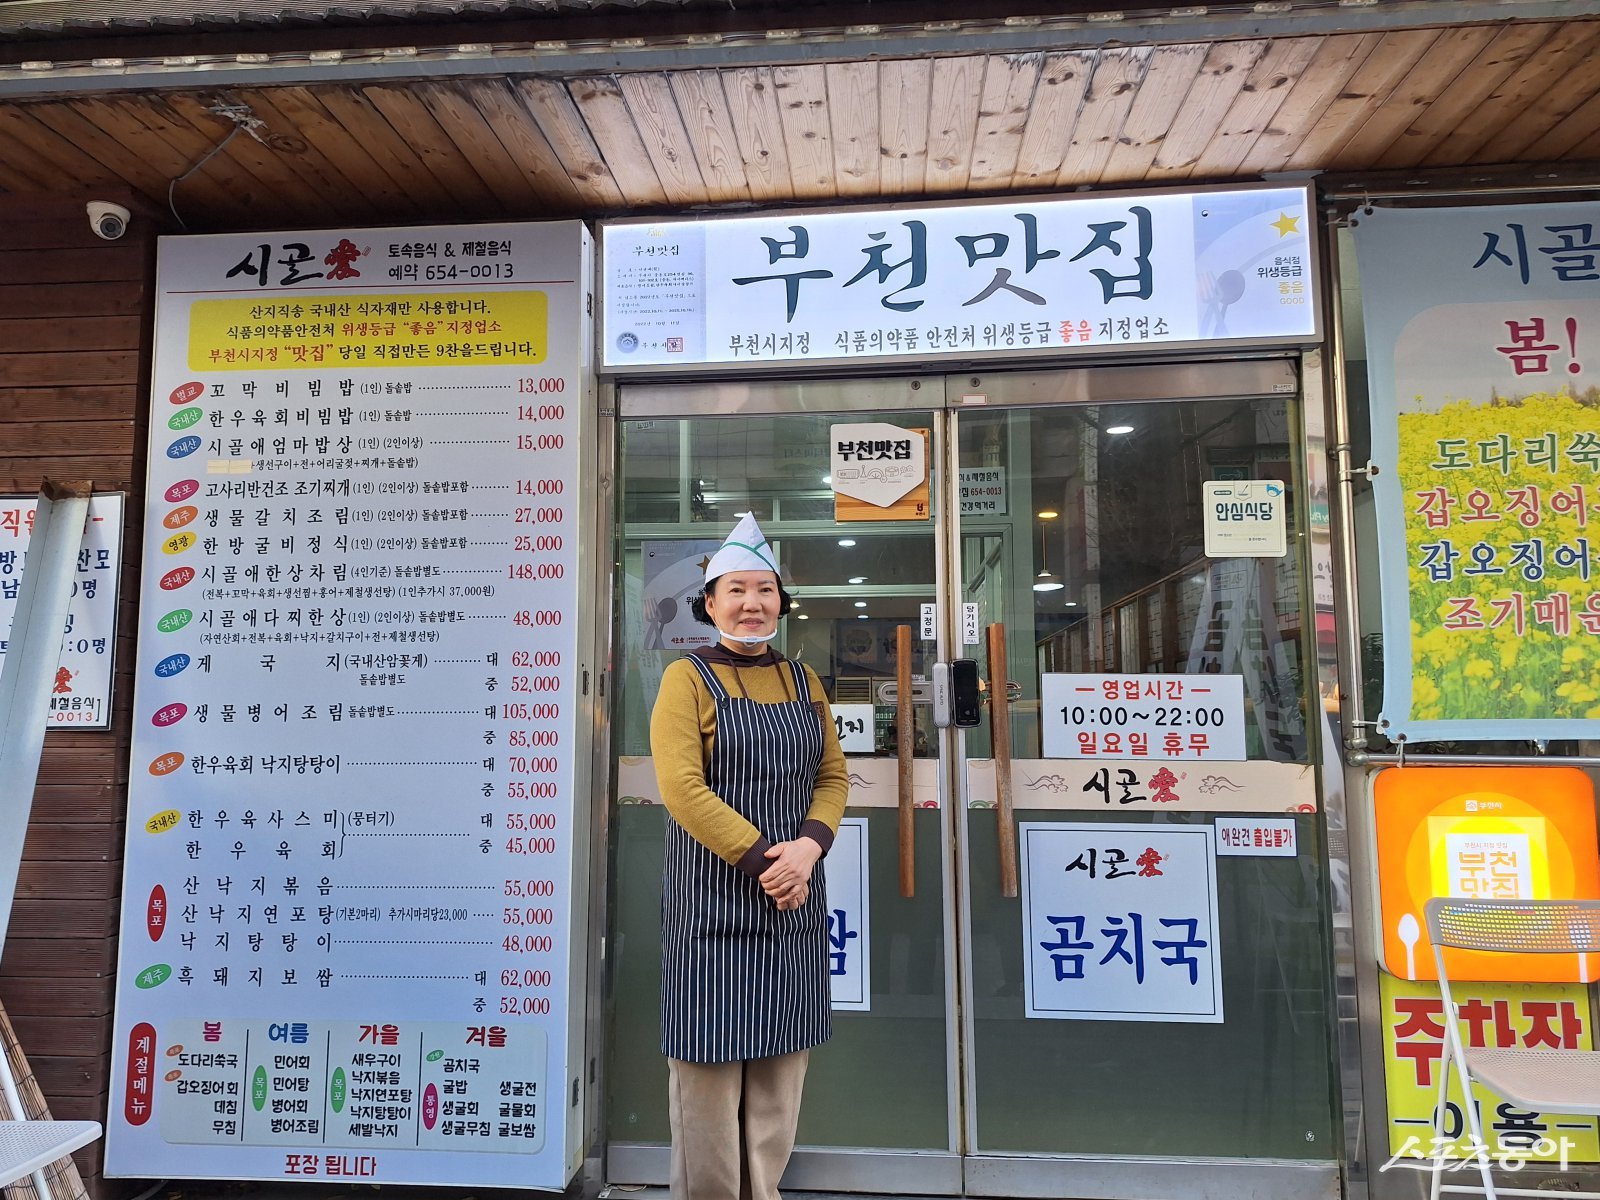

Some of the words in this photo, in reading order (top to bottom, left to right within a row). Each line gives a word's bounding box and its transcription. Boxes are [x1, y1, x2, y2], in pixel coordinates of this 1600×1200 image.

[388, 244, 438, 258] 토속음식
[462, 239, 513, 256] 제철음식
[632, 244, 680, 256] 부천맛집
[1474, 223, 1600, 284] 시골
[732, 206, 1152, 323] 부천맛집
[1274, 256, 1300, 265] 음식점
[388, 264, 418, 281] 예약
[425, 263, 514, 280] 654-0013
[1257, 265, 1303, 278] 위생등급
[1278, 281, 1304, 294] 좋음
[250, 304, 304, 319] 산지직송
[310, 303, 352, 318] 국내산
[356, 302, 412, 317] 식자재만
[418, 300, 492, 316] 사용합니다.
[1280, 297, 1305, 305] GOOD
[226, 322, 335, 338] 식품의약품안전처
[342, 321, 395, 336] 위생등급
[446, 318, 502, 334] 지정업소
[729, 331, 810, 357] 부천시지정
[834, 326, 919, 354] 식품의약품
[926, 322, 976, 351] 안전처
[983, 320, 1051, 346] 위생등급
[1058, 319, 1092, 343] 좋음
[1098, 316, 1170, 340] 지정업소
[208, 347, 278, 364] 부천시지정
[339, 344, 367, 360] 당일
[374, 343, 431, 359] 직접만든
[436, 341, 537, 358] 9찬을드립니다.
[1496, 317, 1582, 376] 봄!
[176, 385, 197, 402] 벌교
[210, 378, 354, 399] 꼬막비빔밥
[516, 378, 564, 395] 13,000
[171, 411, 199, 428] 국내산
[209, 406, 354, 428] 한우육회비빔밥
[516, 405, 564, 422] 14,000
[170, 438, 196, 457] 국내산
[208, 436, 352, 456] 시골애엄마밥상
[516, 434, 564, 452] 15,000
[837, 439, 911, 462] 부천맛집
[171, 484, 193, 498] 목포
[206, 480, 289, 500] 고사리반건조
[294, 478, 350, 498] 조기찌개
[516, 479, 564, 497] 14,000
[970, 487, 1002, 496] 654-0013
[170, 510, 190, 525] 제주
[204, 506, 348, 528] 생물갈치조림
[514, 507, 562, 525] 27,000
[1215, 502, 1273, 522] 안심식당
[1416, 486, 1600, 528] 갑오징어
[203, 534, 348, 555] 한방굴비정식
[514, 536, 562, 554] 25,000
[1420, 539, 1600, 581] 갑오징어
[163, 570, 190, 588] 국내산
[202, 564, 346, 583] 시골애한상차림
[508, 564, 564, 581] 148,000
[160, 612, 188, 630] 국내산
[200, 608, 346, 628] 시골애다찌한상
[512, 610, 562, 628] 48,000
[924, 606, 932, 636] 고정문
[966, 606, 976, 637] 당기시오
[158, 656, 187, 677] 국내산
[486, 652, 498, 667] 대
[512, 650, 560, 670] 62,000
[485, 676, 498, 692] 중
[511, 676, 560, 694] 52,000
[1102, 680, 1184, 700] 영업시간
[194, 703, 343, 722] 생물병어조림
[485, 704, 497, 720] 대
[502, 704, 559, 722] 105,000
[1060, 706, 1224, 726] 10:00~22:00
[482, 731, 497, 745] 중
[508, 729, 558, 748] 85,000
[1077, 732, 1148, 756] 일요일
[1162, 732, 1210, 756] 휴무
[190, 754, 254, 776] 한우육회
[261, 754, 341, 776] 낙지탕탕이
[482, 757, 495, 774] 대
[508, 756, 558, 776] 70,000
[481, 783, 496, 799] 중
[508, 782, 557, 801] 55,000
[148, 812, 176, 831] 국내산
[188, 808, 338, 831] 한우육사스미
[480, 813, 493, 829] 대
[506, 813, 556, 832] 55,000
[478, 839, 493, 854] 중
[505, 837, 556, 857] 45,000
[1220, 828, 1251, 848] 애완견
[1253, 827, 1292, 848] 출입불가
[1458, 851, 1518, 877] 부천
[184, 876, 332, 896] 산낙지볶음
[504, 880, 554, 899] 55,000
[180, 905, 332, 926] 산낙지연포탕
[502, 907, 553, 927] 55,000
[180, 932, 332, 952] 낙지탕탕이
[502, 935, 552, 954] 48,000
[1040, 912, 1208, 986] 곰치국
[178, 966, 332, 988] 흑돼지보쌈
[475, 970, 487, 986] 대
[500, 969, 551, 989] 62,000
[472, 998, 487, 1014] 중
[500, 996, 550, 1016] 52,000
[202, 1022, 222, 1042] 봄
[268, 1022, 310, 1044] 여름
[358, 1024, 400, 1045] 가을
[466, 1026, 508, 1048] 겨울
[178, 1054, 238, 1069] 도다리쑥국
[274, 1055, 310, 1070] 민어회
[352, 1053, 401, 1068] 새우구이
[443, 1058, 480, 1074] 곰치국
[130, 1036, 150, 1116] 계절메뉴
[272, 1077, 310, 1092] 민어탕
[352, 1070, 400, 1086] 낙지볶음
[176, 1080, 224, 1095] 갑오징어
[351, 1088, 412, 1103] 낙지연포탕
[443, 1080, 468, 1094] 굴밥
[500, 1081, 536, 1097] 생굴전
[214, 1100, 238, 1115] 데침
[271, 1098, 308, 1114] 병어회
[350, 1106, 412, 1120] 낙지탕탕이
[442, 1100, 479, 1116] 생굴회
[498, 1102, 536, 1118] 굴물회
[212, 1120, 236, 1135] 무침
[270, 1118, 319, 1134] 병어조림
[348, 1123, 398, 1138] 세발낙지
[441, 1120, 490, 1136] 생굴무침
[498, 1122, 536, 1138] 굴보쌈
[284, 1154, 320, 1174] 포장
[325, 1155, 377, 1176] 됩니다
